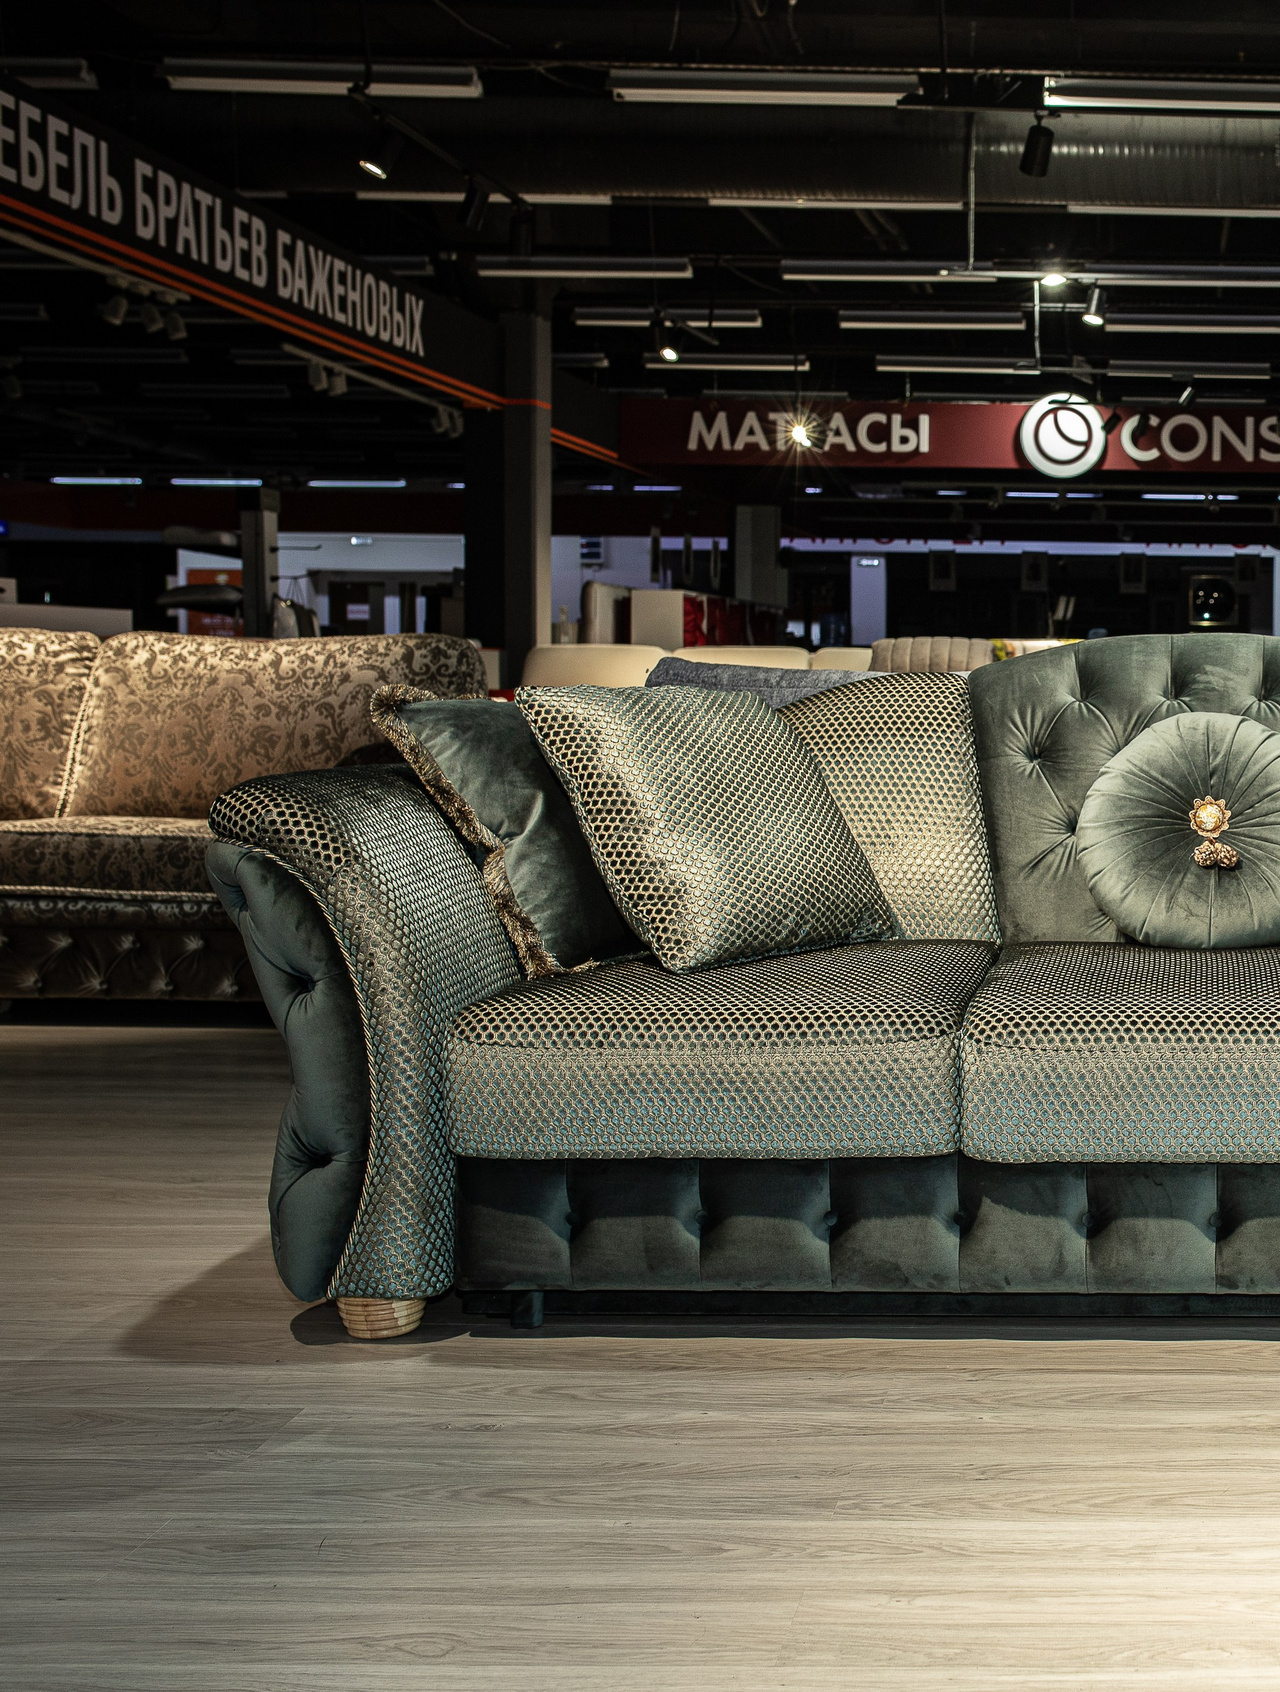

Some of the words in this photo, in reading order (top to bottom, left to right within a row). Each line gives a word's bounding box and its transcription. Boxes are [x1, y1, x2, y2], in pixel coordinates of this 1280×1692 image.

[134, 158, 268, 288] БРАТЬЕВ
[276, 229, 425, 358] БАЖЕНОВЫХ
[687, 411, 930, 454] МАТАСЫ
